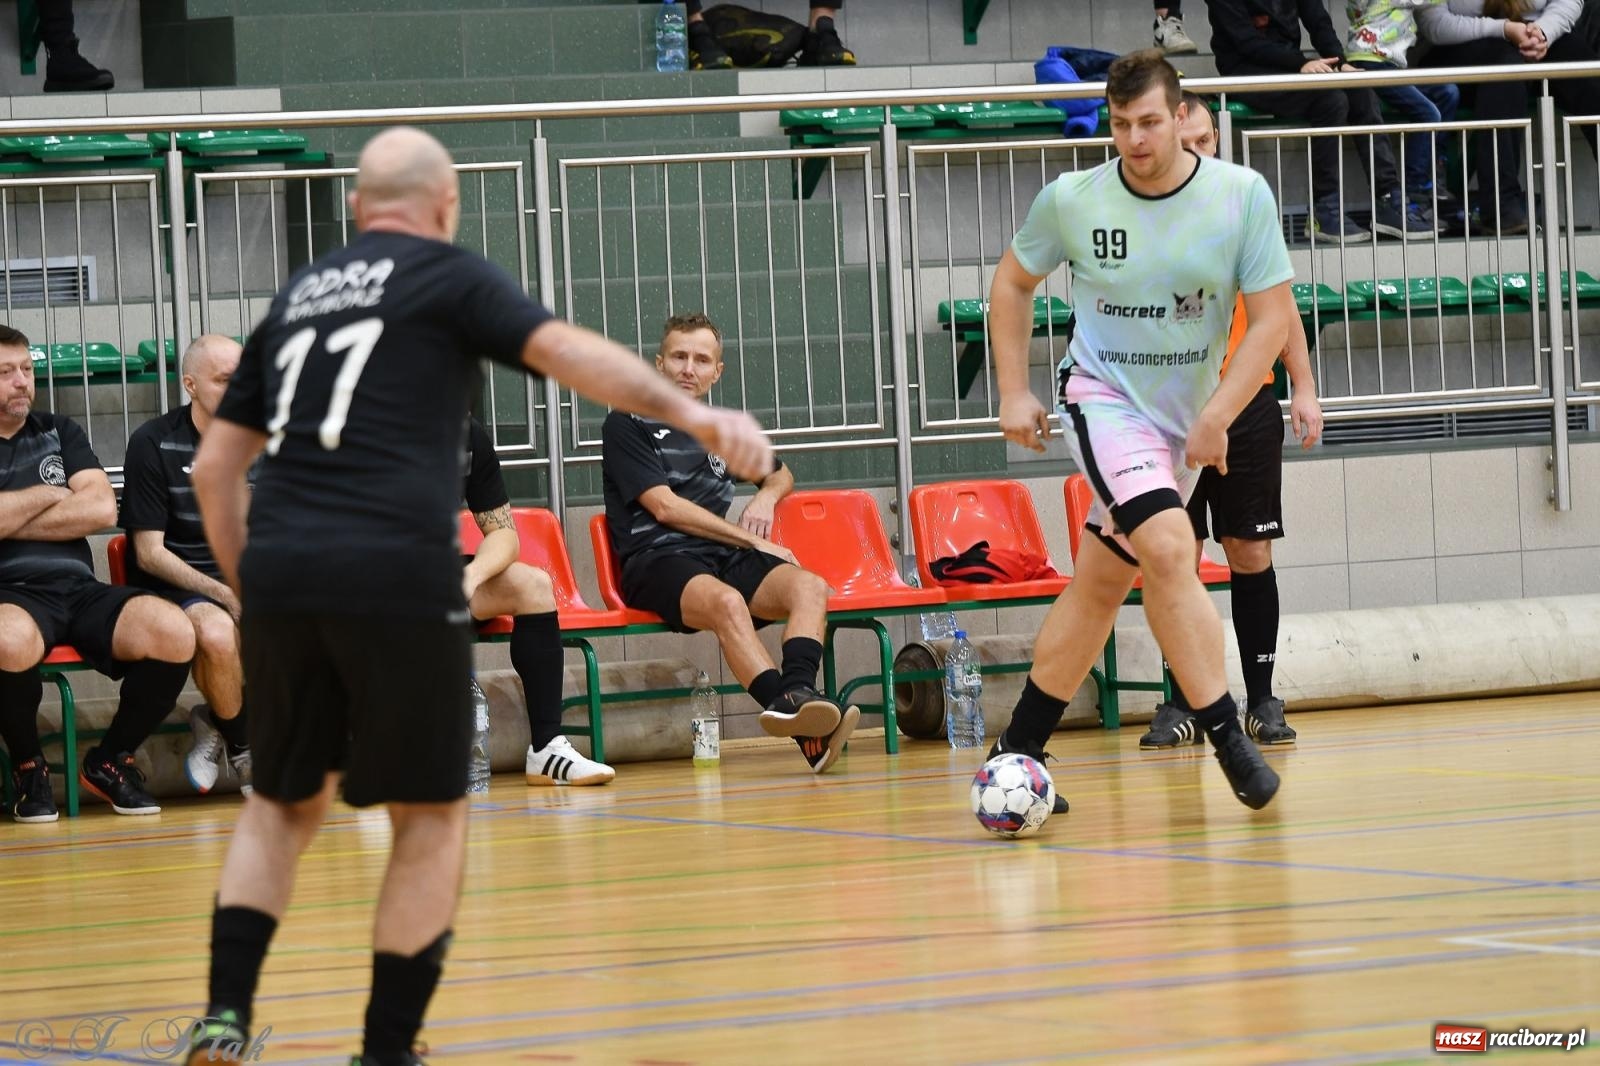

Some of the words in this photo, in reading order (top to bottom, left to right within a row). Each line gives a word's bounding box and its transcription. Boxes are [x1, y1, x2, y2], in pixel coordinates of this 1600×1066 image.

[1092, 228, 1127, 260] 99
[289, 258, 395, 305] ODRA
[1097, 298, 1166, 318] Concrete
[1098, 344, 1209, 367] www.concretedm.pl
